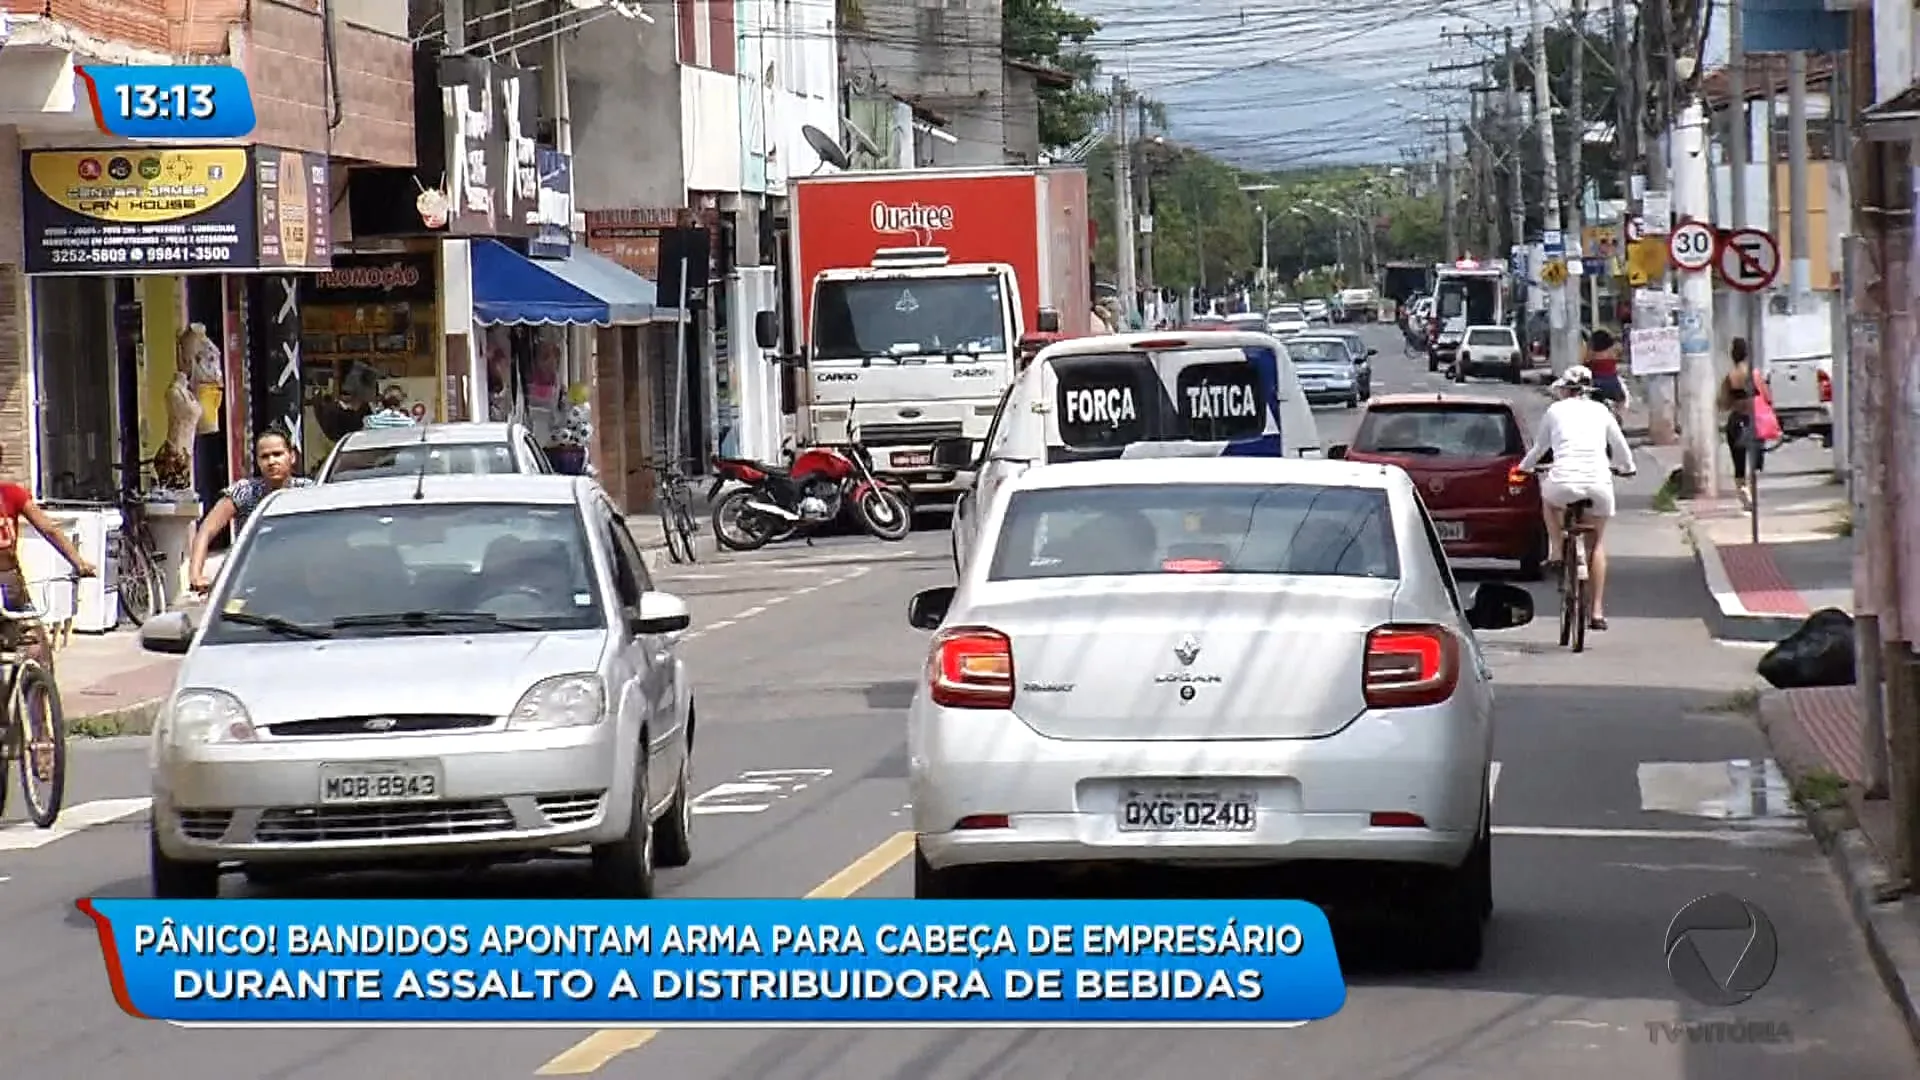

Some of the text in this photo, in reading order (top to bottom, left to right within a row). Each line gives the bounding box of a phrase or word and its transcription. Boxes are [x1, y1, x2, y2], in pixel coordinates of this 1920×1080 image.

[79, 199, 196, 211] LAN HOUSE
[1676, 232, 1709, 254] 30
[316, 263, 420, 293] PROMOÇÃO
[817, 372, 858, 383] CARGO
[1066, 378, 1257, 430] FORÇA TÁTICA
